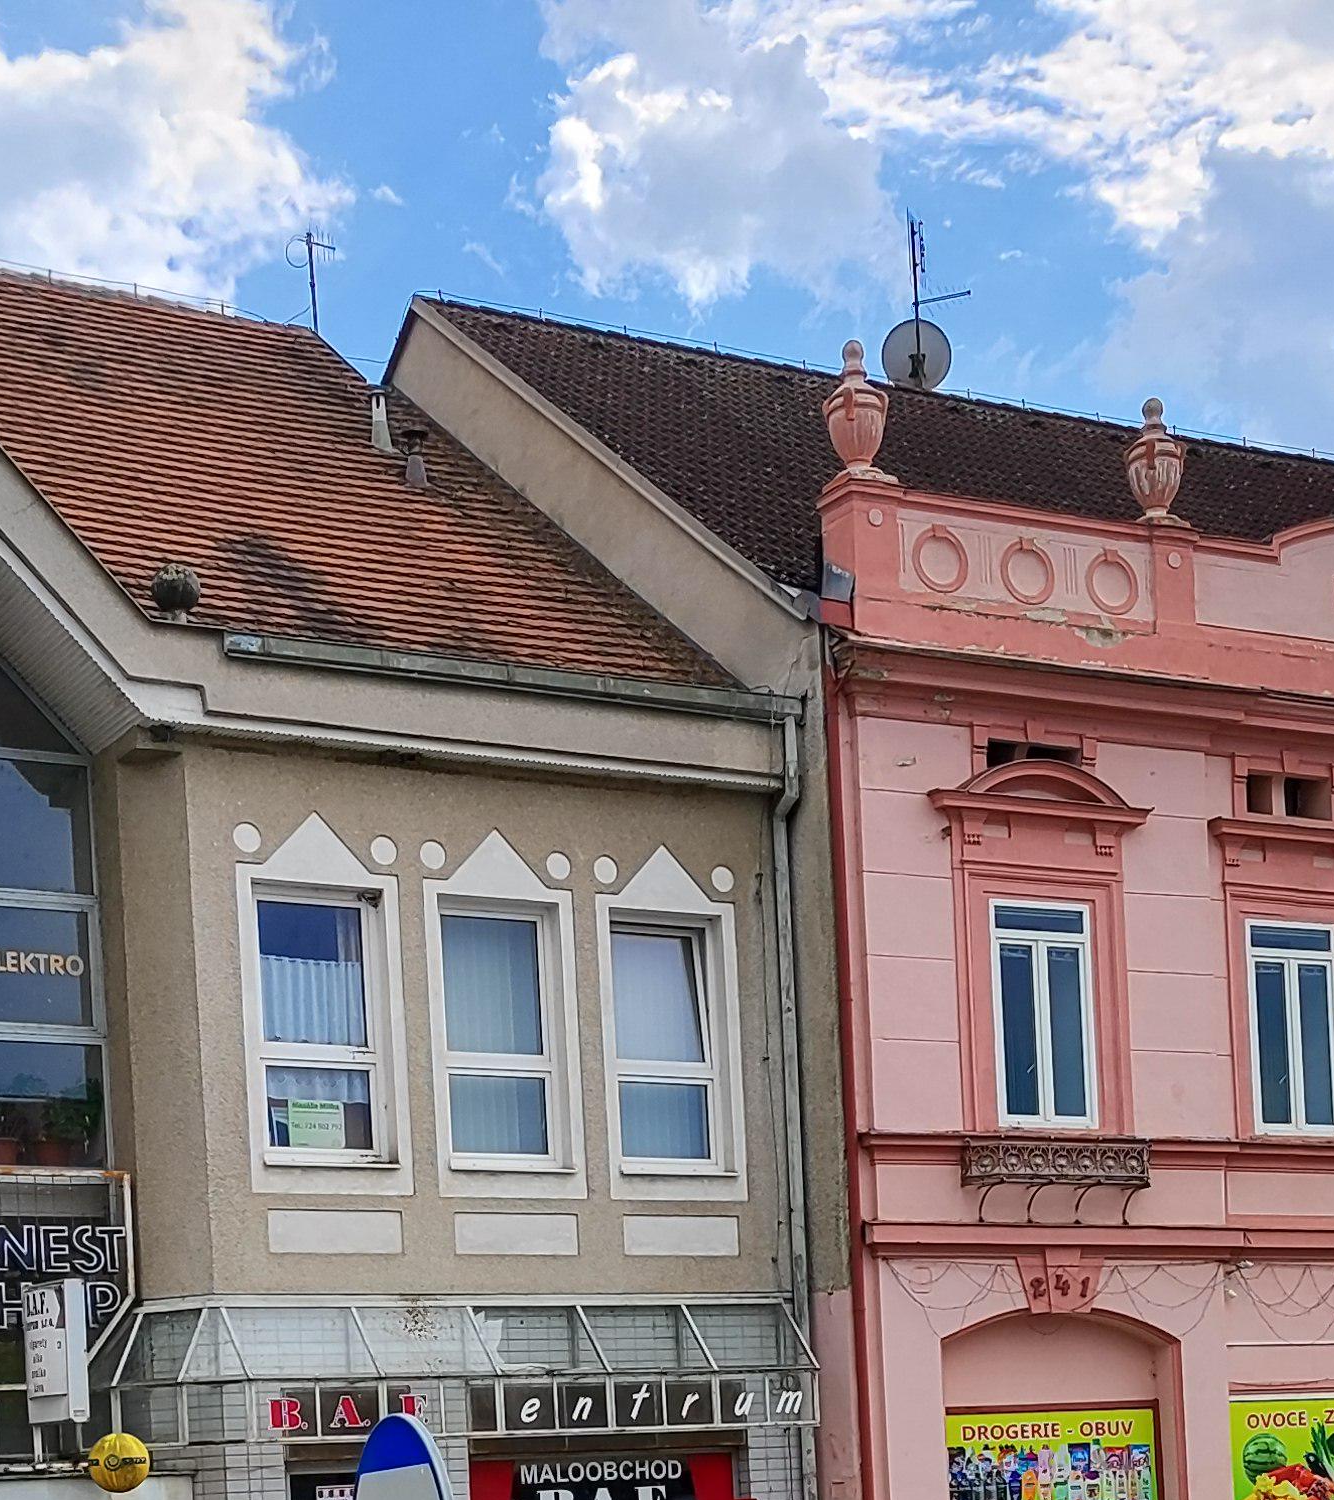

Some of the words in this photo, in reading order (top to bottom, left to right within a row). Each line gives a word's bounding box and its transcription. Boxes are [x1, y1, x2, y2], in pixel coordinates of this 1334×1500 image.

[1030, 1274, 1092, 1300] 241
[962, 1422, 1061, 1441] DROGERIE
[1079, 1420, 1133, 1437] OBUV
[1247, 1410, 1307, 1429] OVOCE
[520, 1460, 682, 1485] MALOOBCHOD
